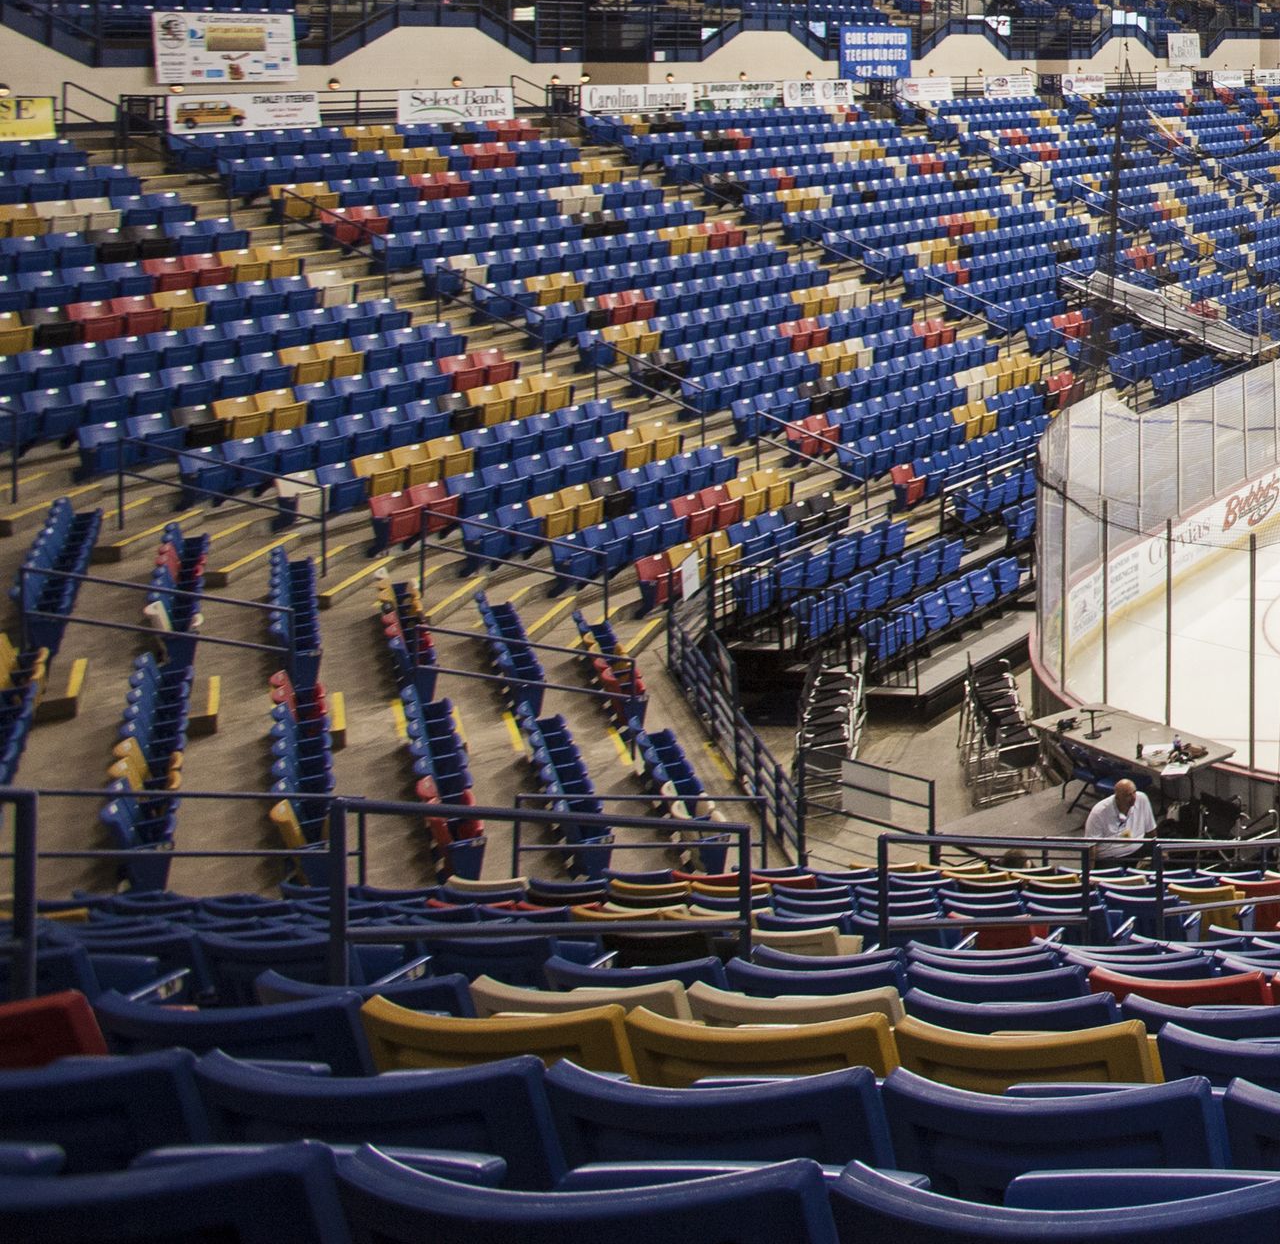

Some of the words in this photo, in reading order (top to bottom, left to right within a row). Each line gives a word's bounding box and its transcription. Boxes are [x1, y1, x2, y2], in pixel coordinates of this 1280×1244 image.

[867, 32, 907, 45] COMPUTER
[845, 48, 907, 62] TECHNOLOGIES
[410, 91, 459, 107] Select
[464, 89, 505, 105] Bank
[589, 87, 639, 108] Carolina
[643, 86, 688, 107] Imaging
[464, 107, 476, 118] &
[477, 106, 505, 116] Trust
[1223, 474, 1280, 532] Bubba's
